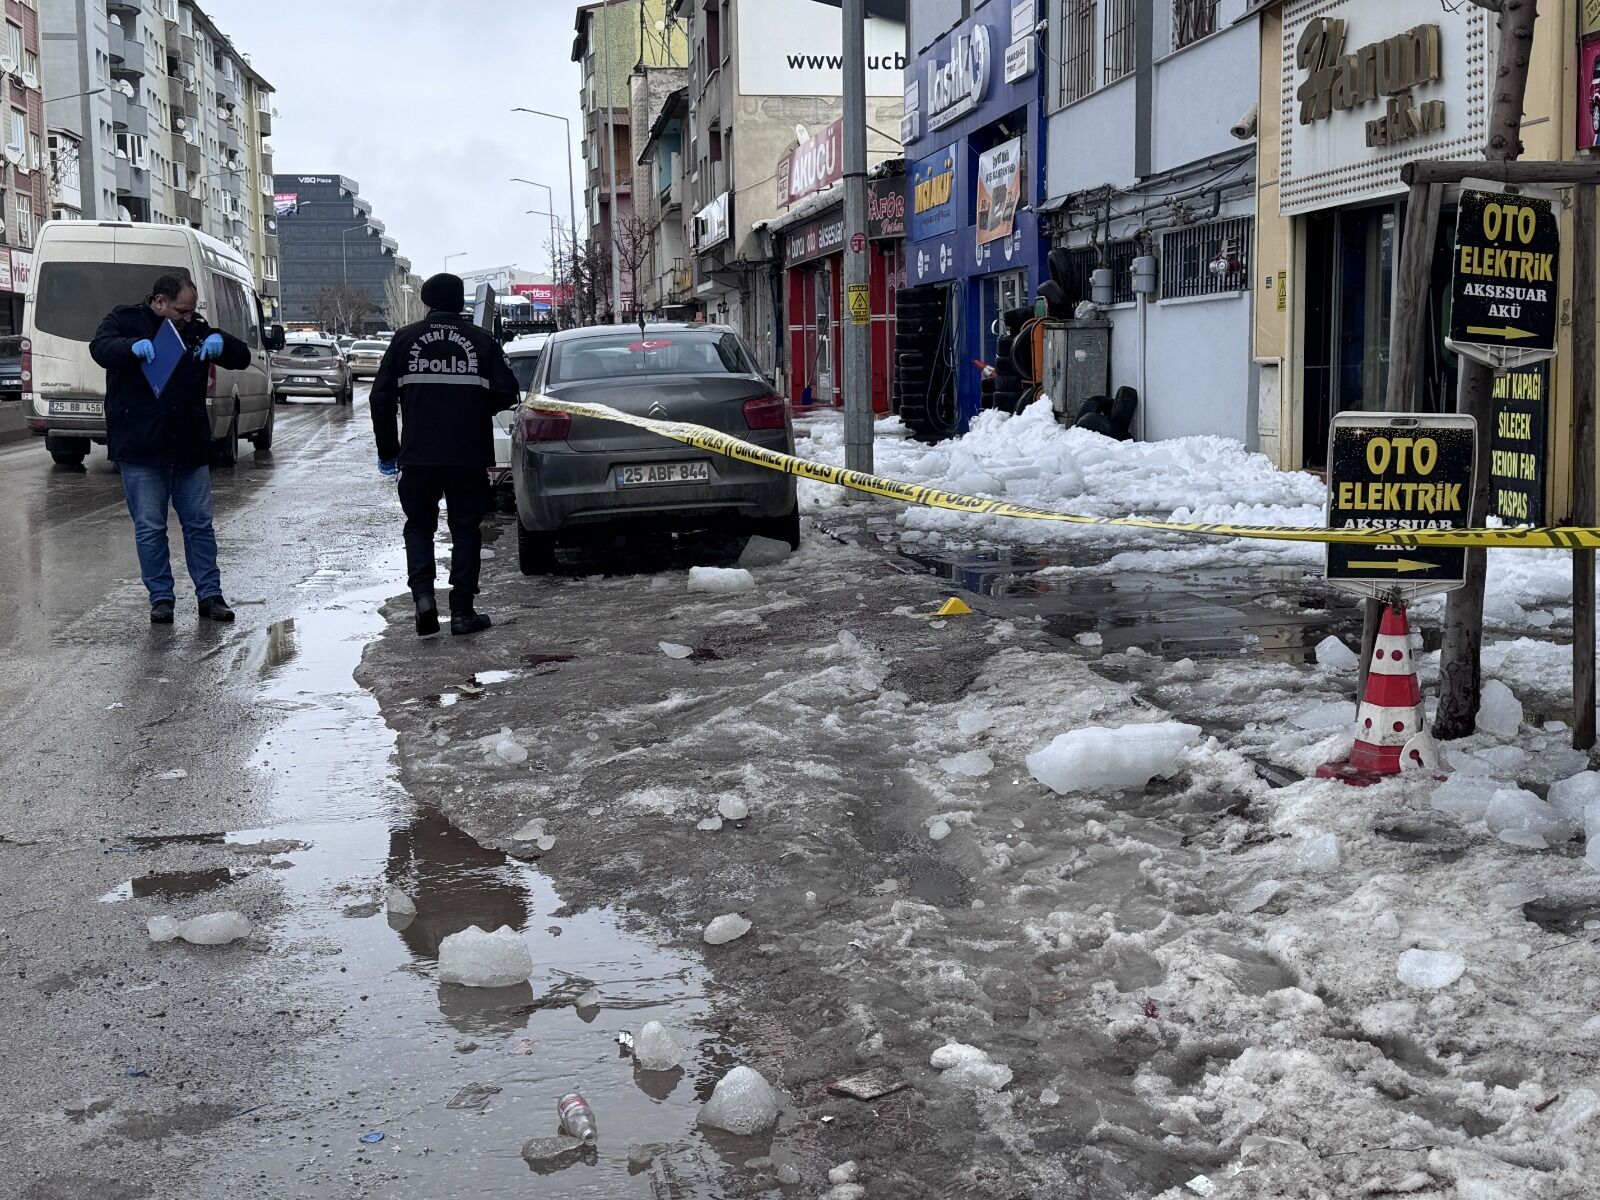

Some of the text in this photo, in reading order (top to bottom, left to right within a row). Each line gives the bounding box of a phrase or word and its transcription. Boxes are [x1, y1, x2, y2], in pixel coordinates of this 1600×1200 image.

[1297, 17, 1439, 125] Harun
[1483, 203, 1536, 244] OTO
[1463, 283, 1547, 302] AKSESUAR
[1488, 303, 1521, 319] AKÜ
[408, 342, 422, 372] OLAY
[1512, 367, 1541, 400] KAPAĞI
[55, 402, 65, 411] 25
[86, 404, 101, 413] 456
[1498, 406, 1532, 440] SİLECEK
[1366, 437, 1438, 475] OTO
[1491, 450, 1536, 481] XENON FAR
[624, 463, 707, 483] 25 ABF 844
[1498, 489, 1528, 519] PASPAS
